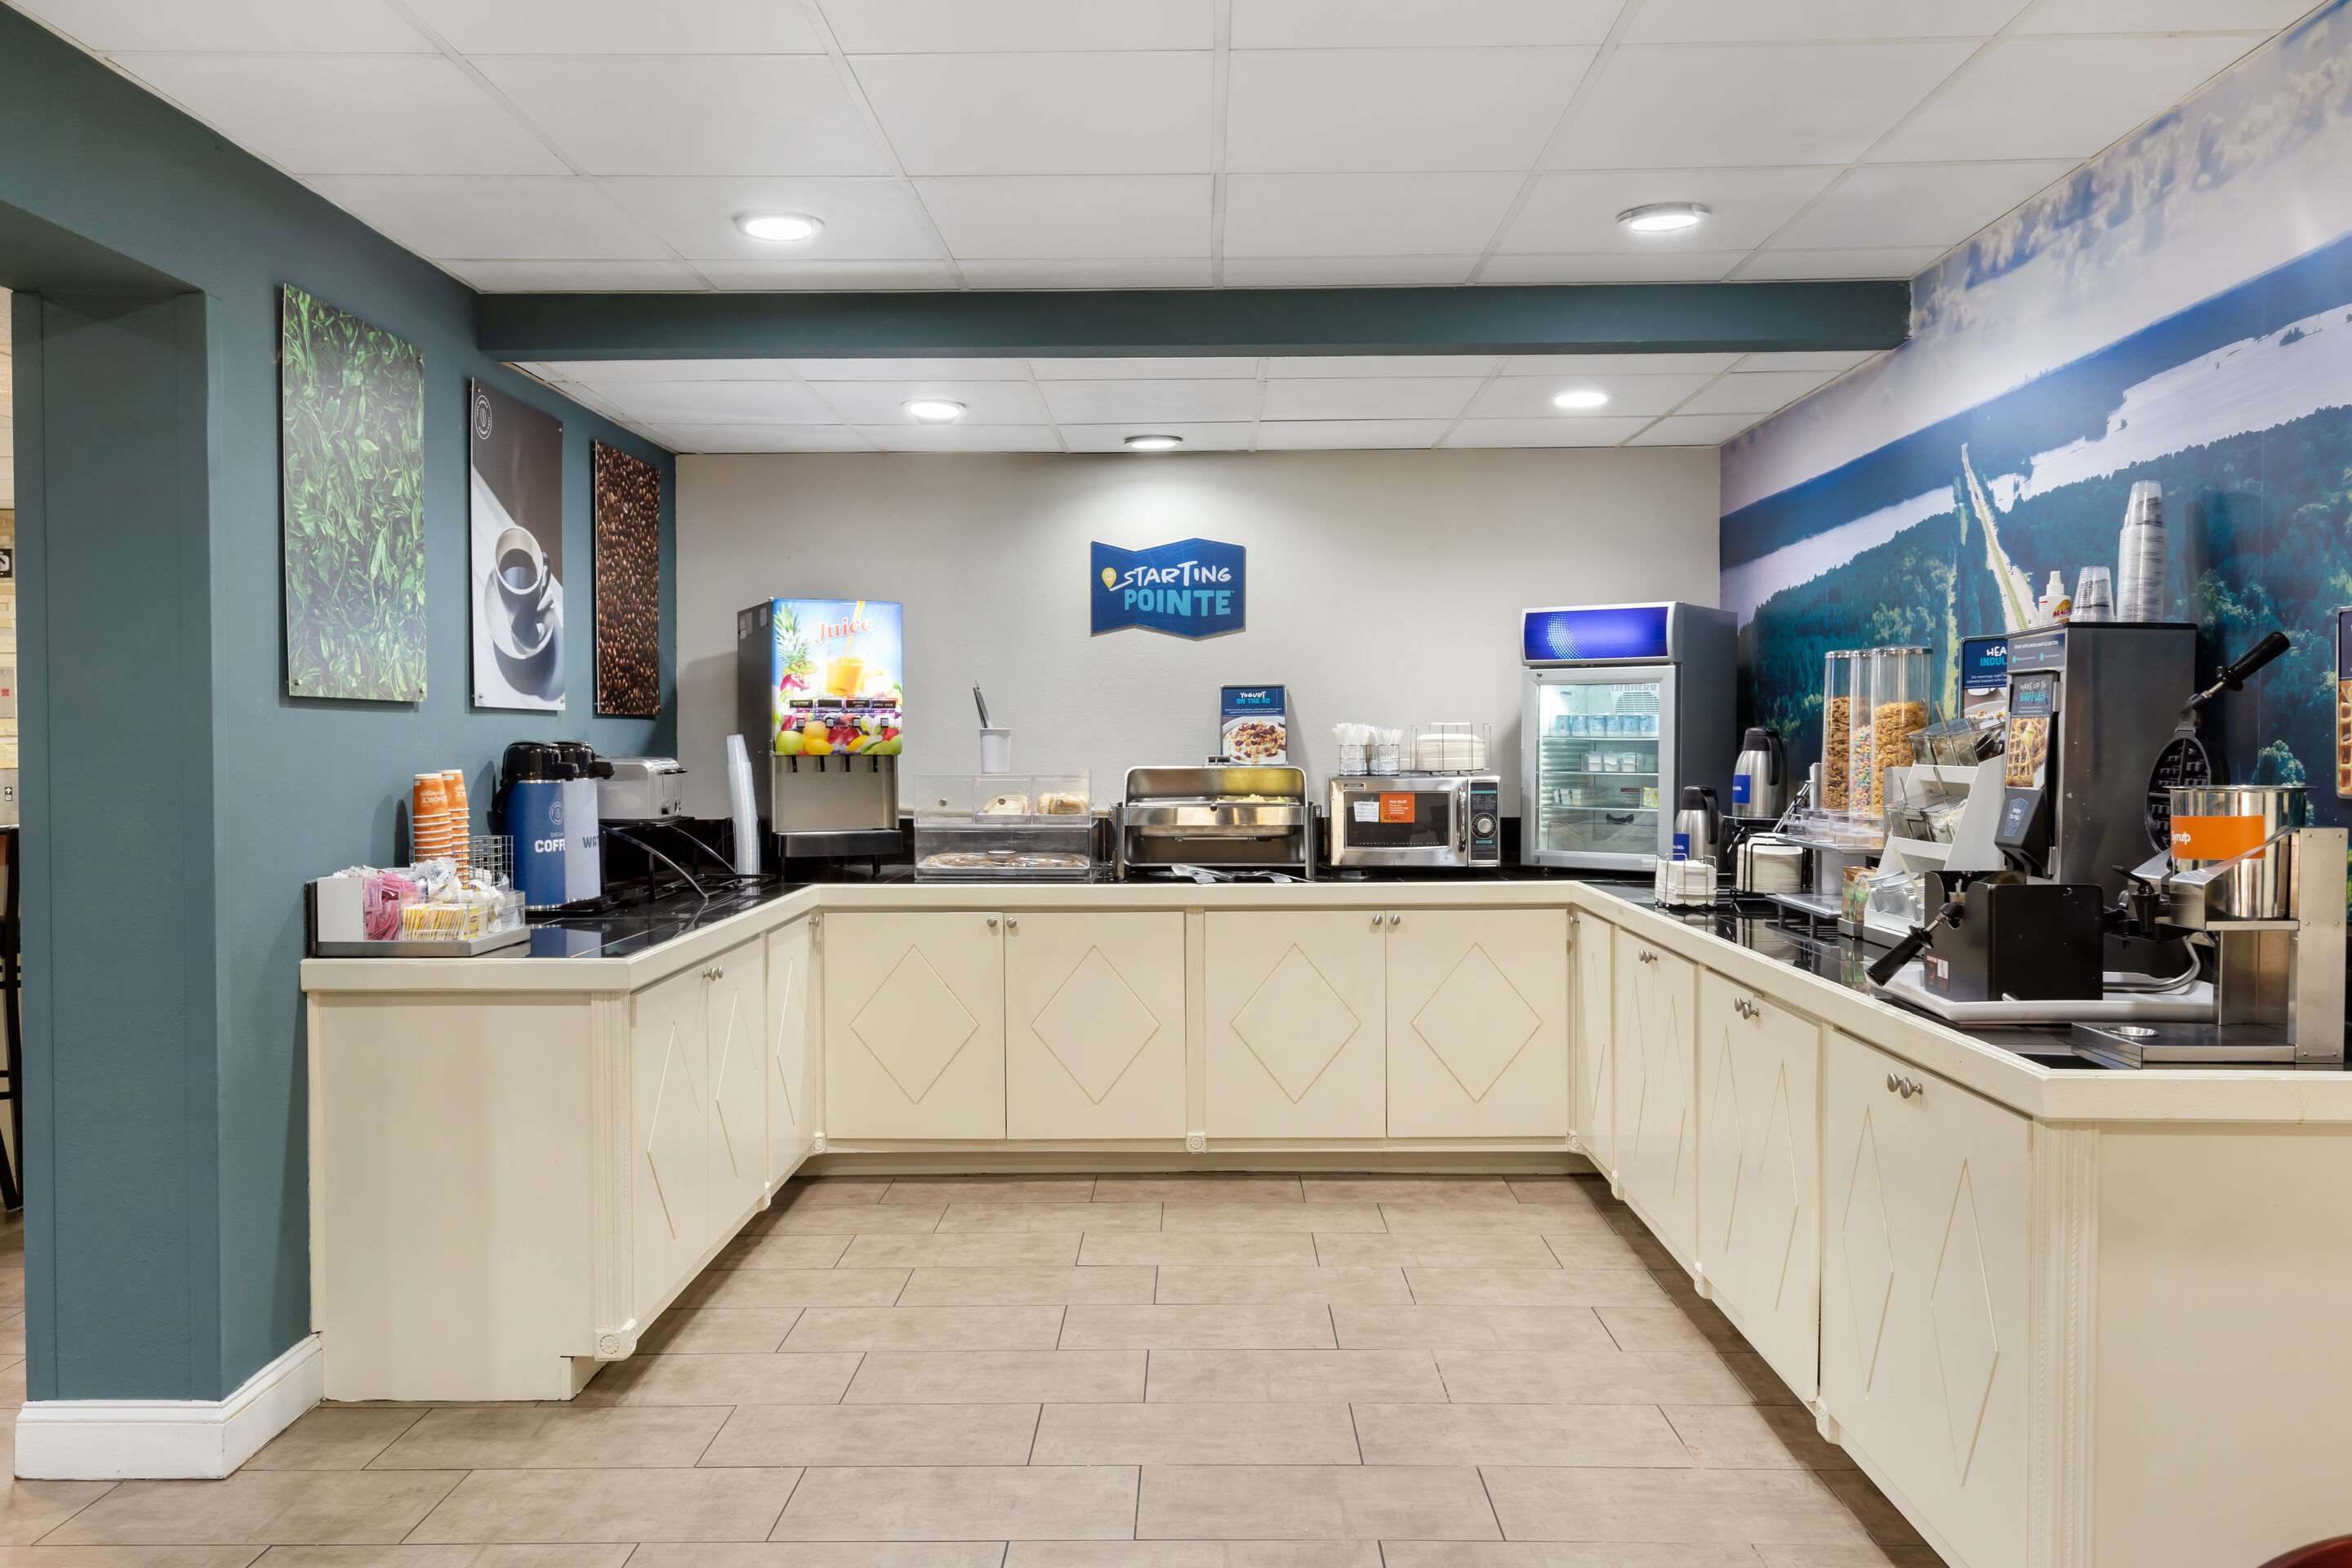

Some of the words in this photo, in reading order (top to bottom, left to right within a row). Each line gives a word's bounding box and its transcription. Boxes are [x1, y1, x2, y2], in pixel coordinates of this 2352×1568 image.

[1124, 588, 1232, 617] POINTE
[815, 617, 874, 644] Juice
[1986, 646, 2007, 657] HEA
[1980, 657, 2007, 667] INDUL
[1610, 684, 1657, 693] LIEBHERR
[534, 839, 565, 853] COFF
